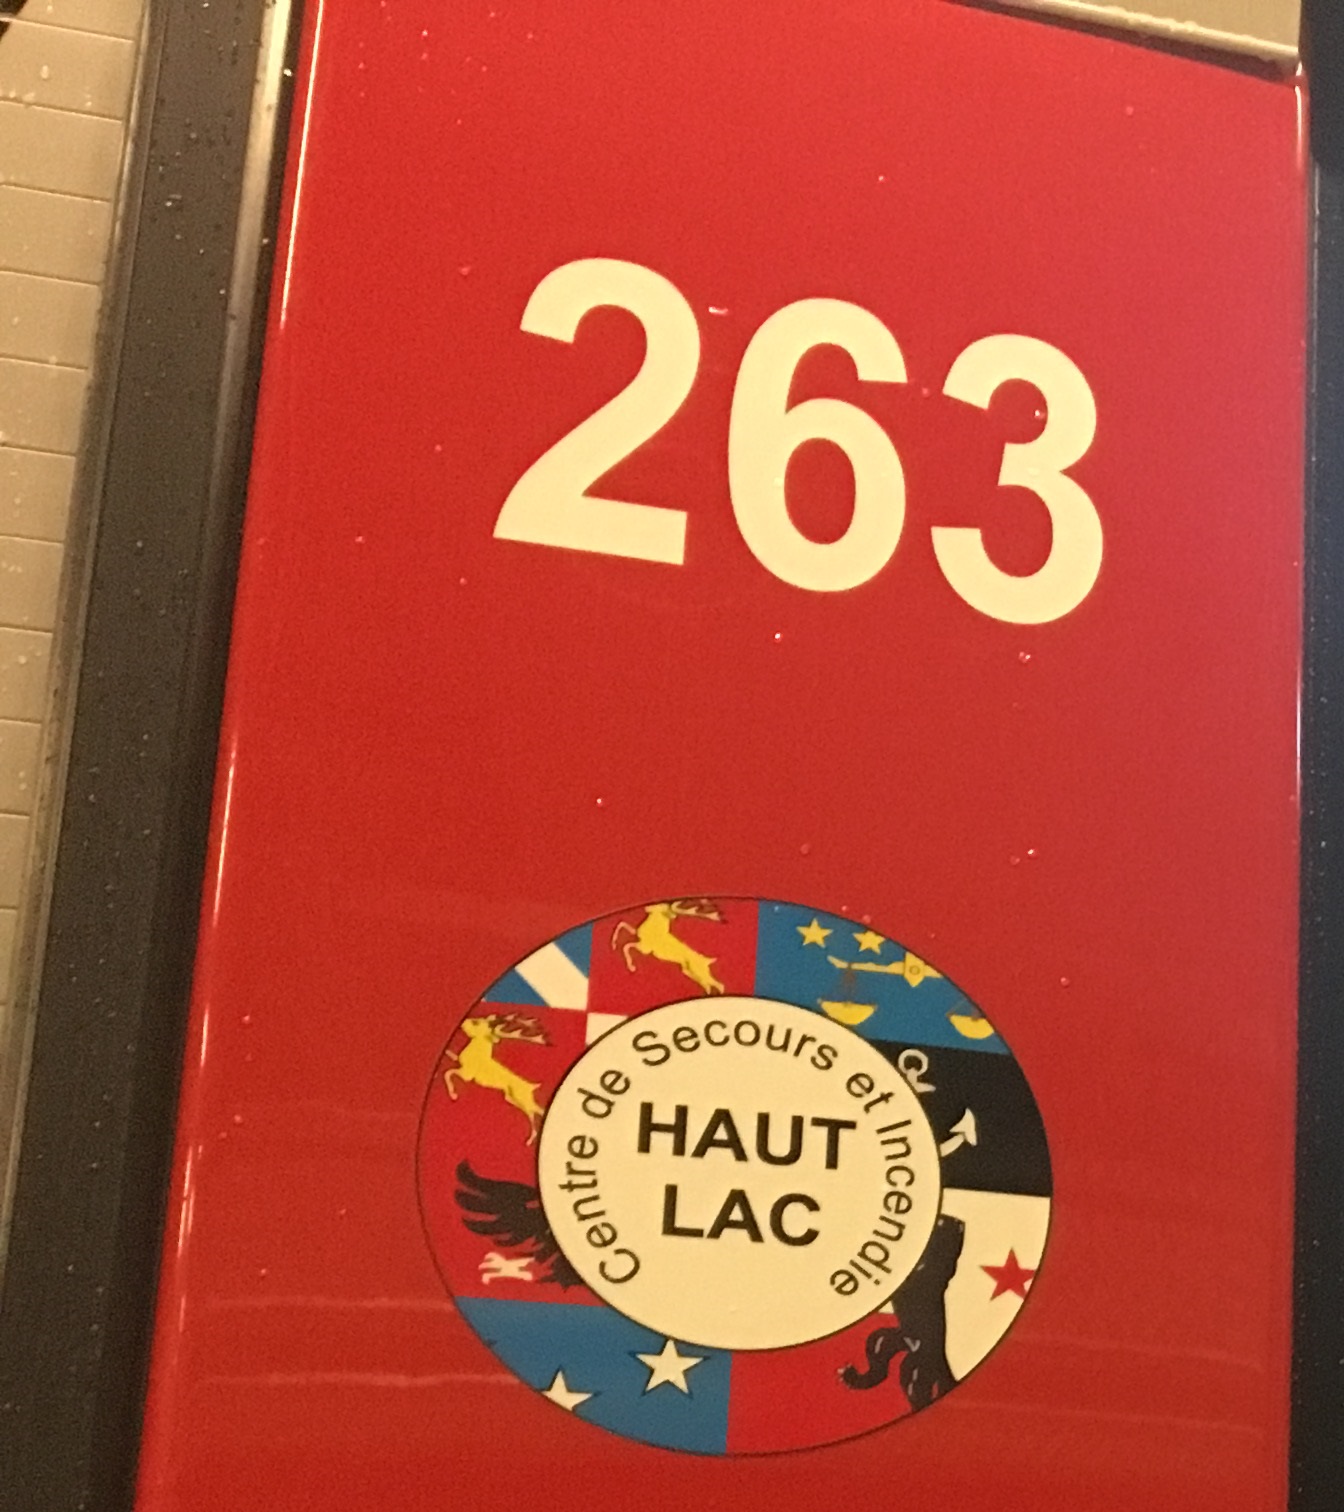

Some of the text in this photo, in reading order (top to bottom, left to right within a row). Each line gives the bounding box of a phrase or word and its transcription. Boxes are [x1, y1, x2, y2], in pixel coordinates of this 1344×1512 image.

[493, 257, 1104, 625] 263
[558, 1019, 916, 1296] Centre de Secours et Incendie
[637, 1101, 858, 1171] HAUT
[661, 1183, 821, 1247] LAC
